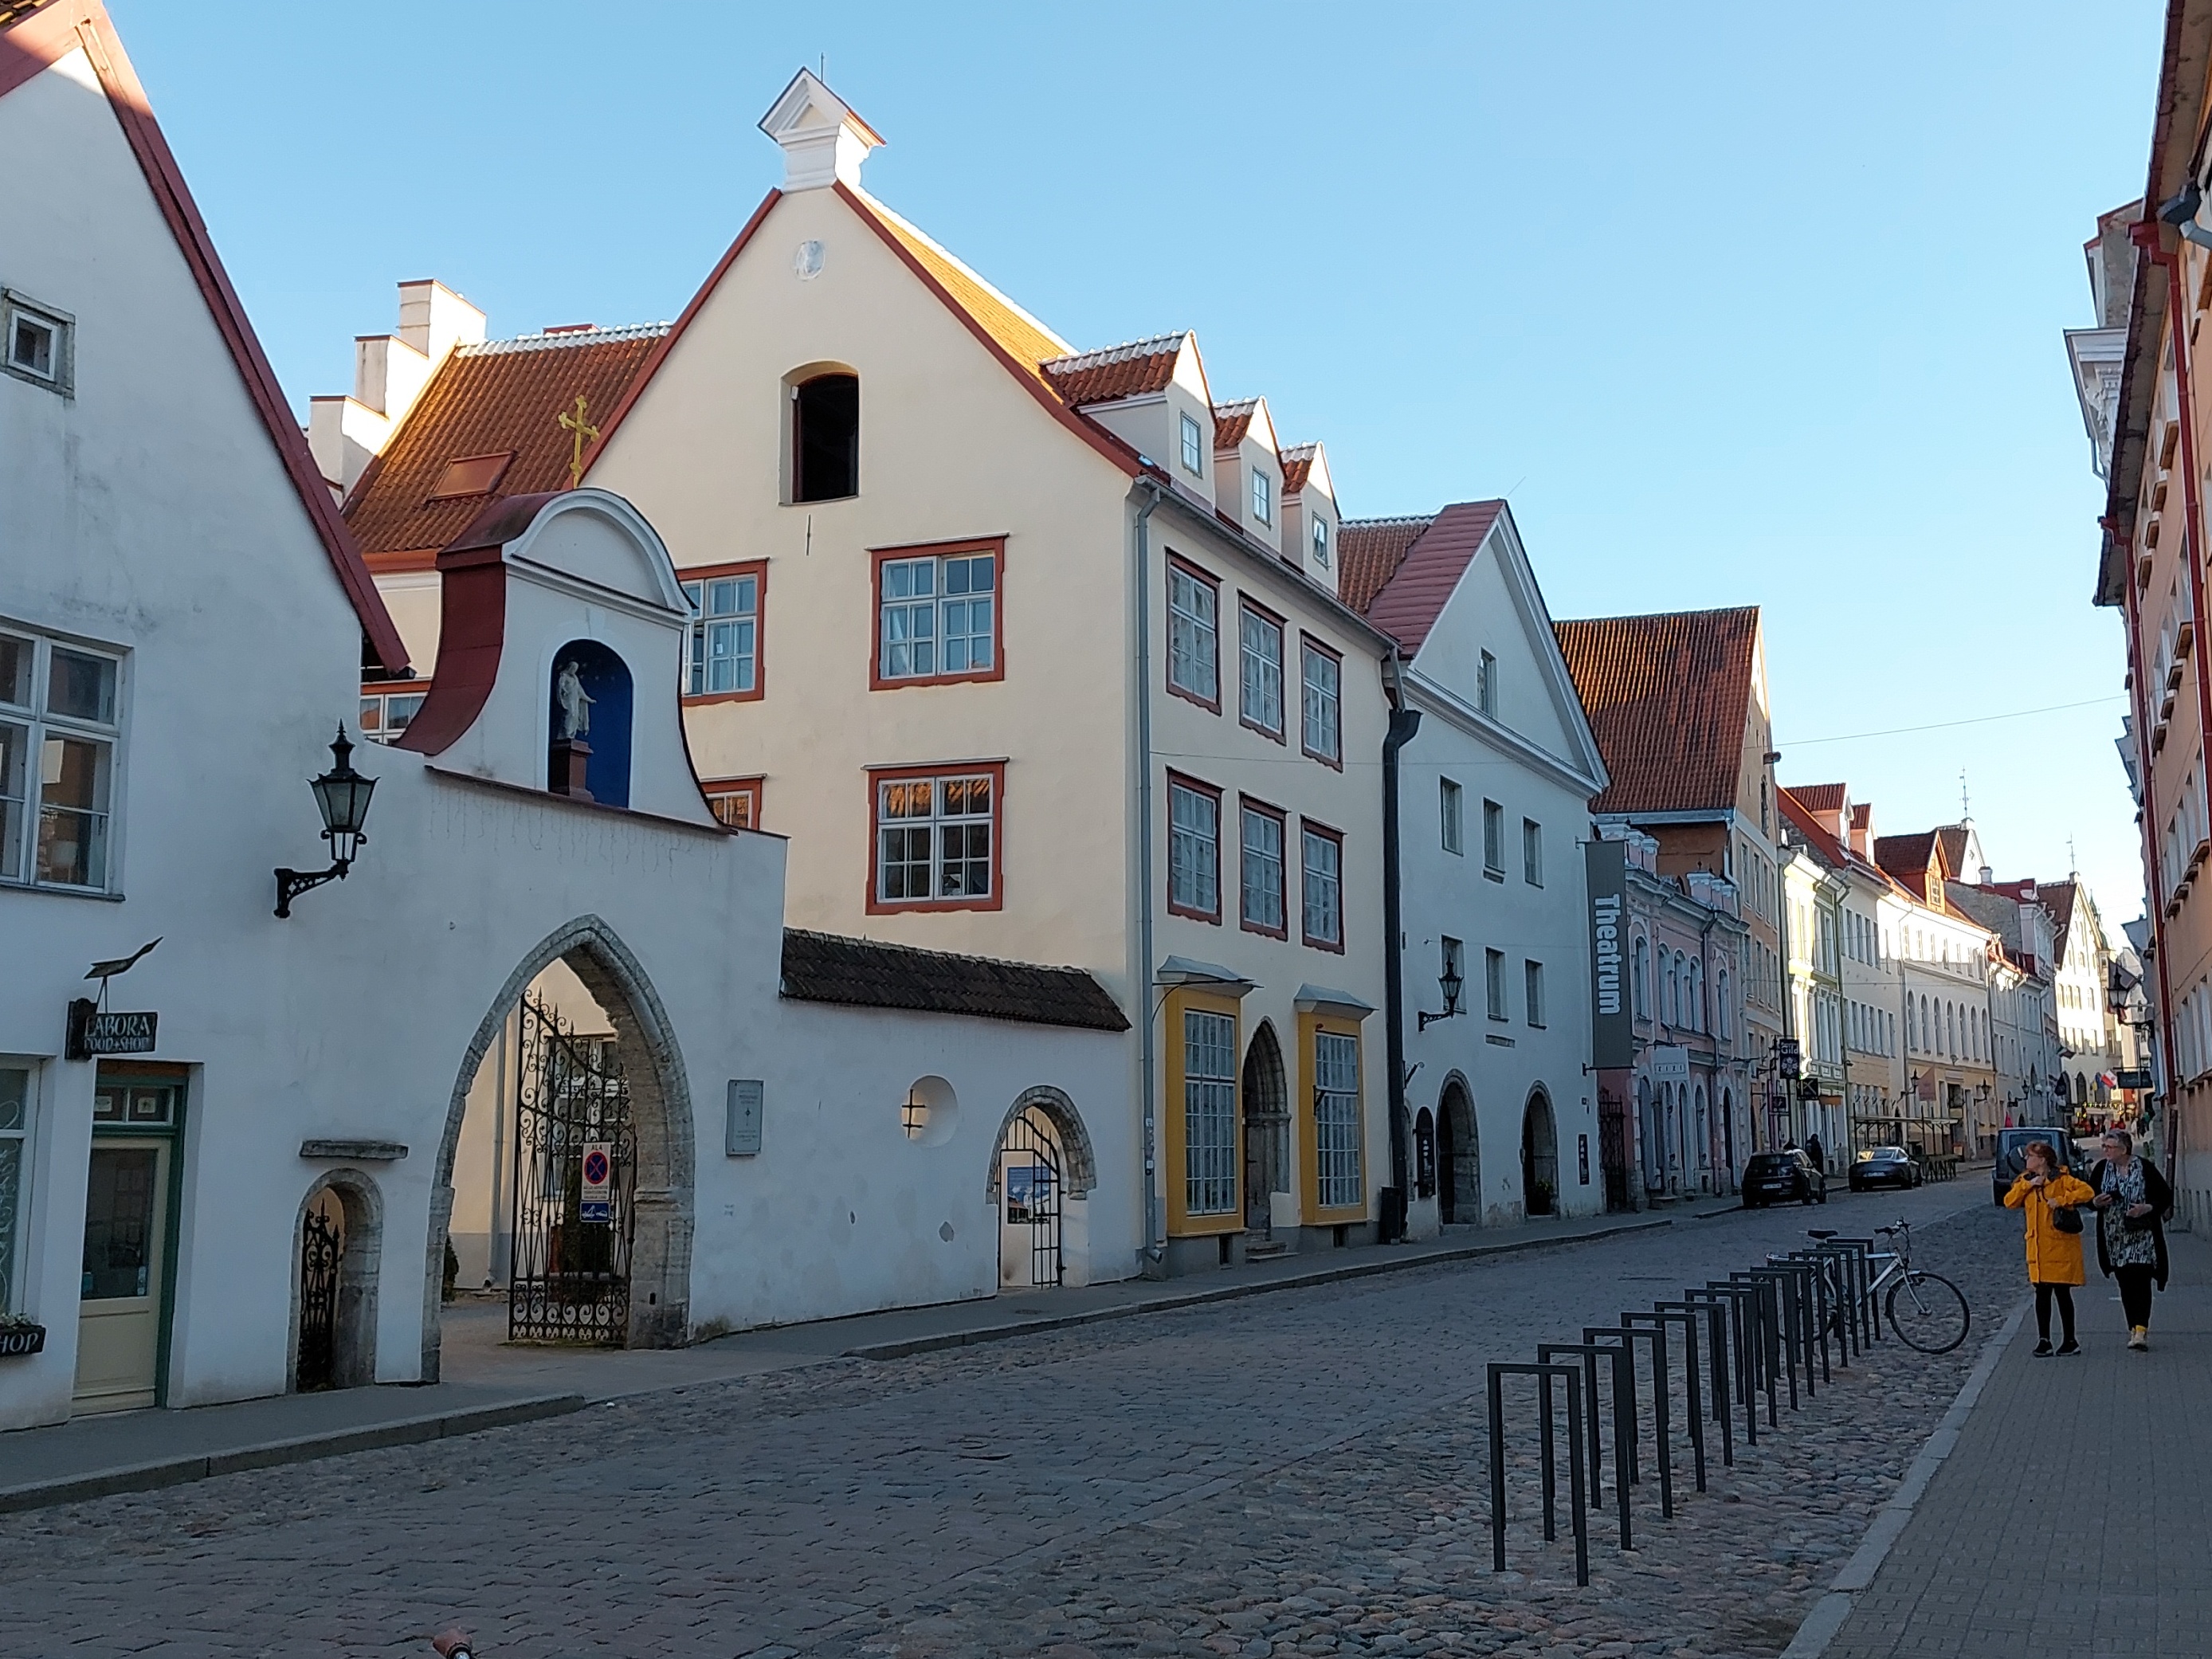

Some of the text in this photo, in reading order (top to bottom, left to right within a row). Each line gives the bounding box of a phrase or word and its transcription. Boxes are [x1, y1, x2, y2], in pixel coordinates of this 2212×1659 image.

[1594, 893, 1622, 1014] Theatrum
[84, 1015, 151, 1037] LABORA
[1781, 1044, 1799, 1054] Gild
